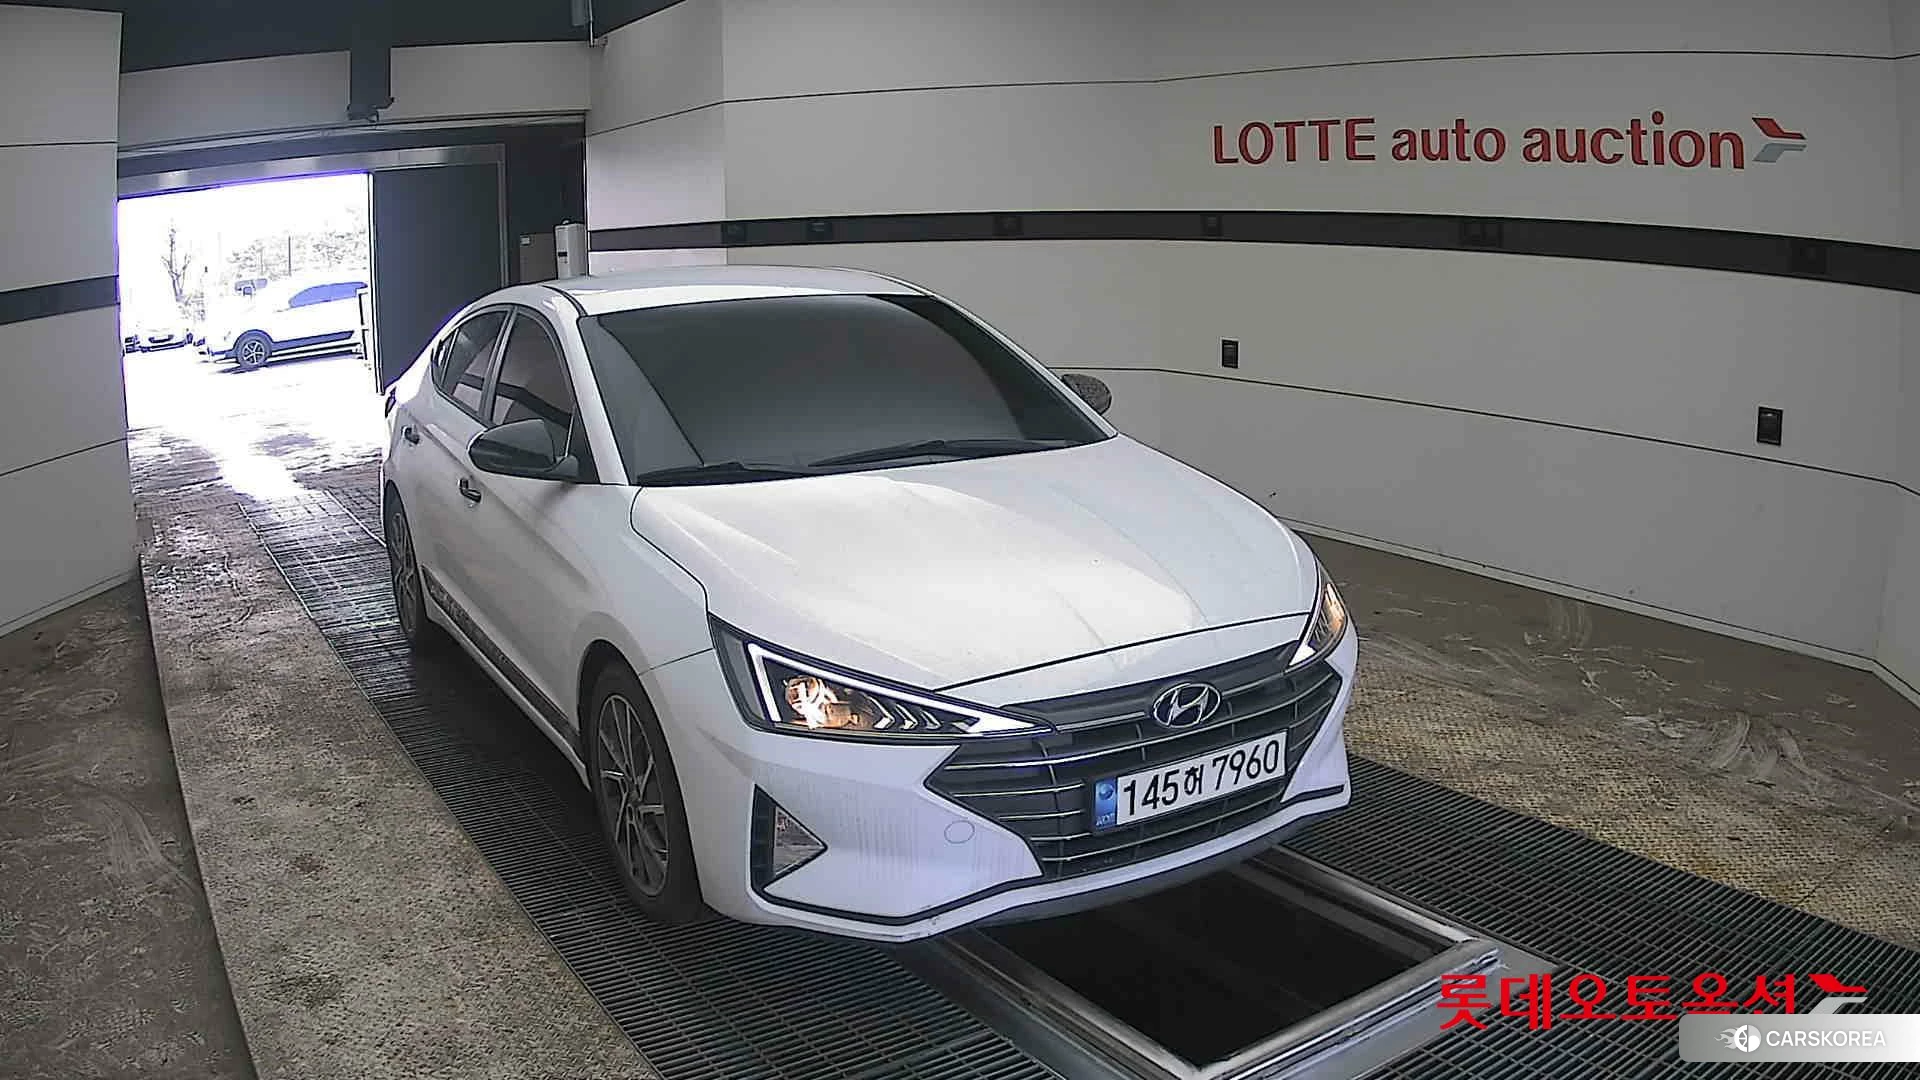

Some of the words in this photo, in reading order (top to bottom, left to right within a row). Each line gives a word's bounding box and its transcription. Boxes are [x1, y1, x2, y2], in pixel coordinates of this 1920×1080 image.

[1213, 117, 1376, 164] LOTTE
[1391, 119, 1507, 162] auto
[1522, 111, 1746, 169] auction
